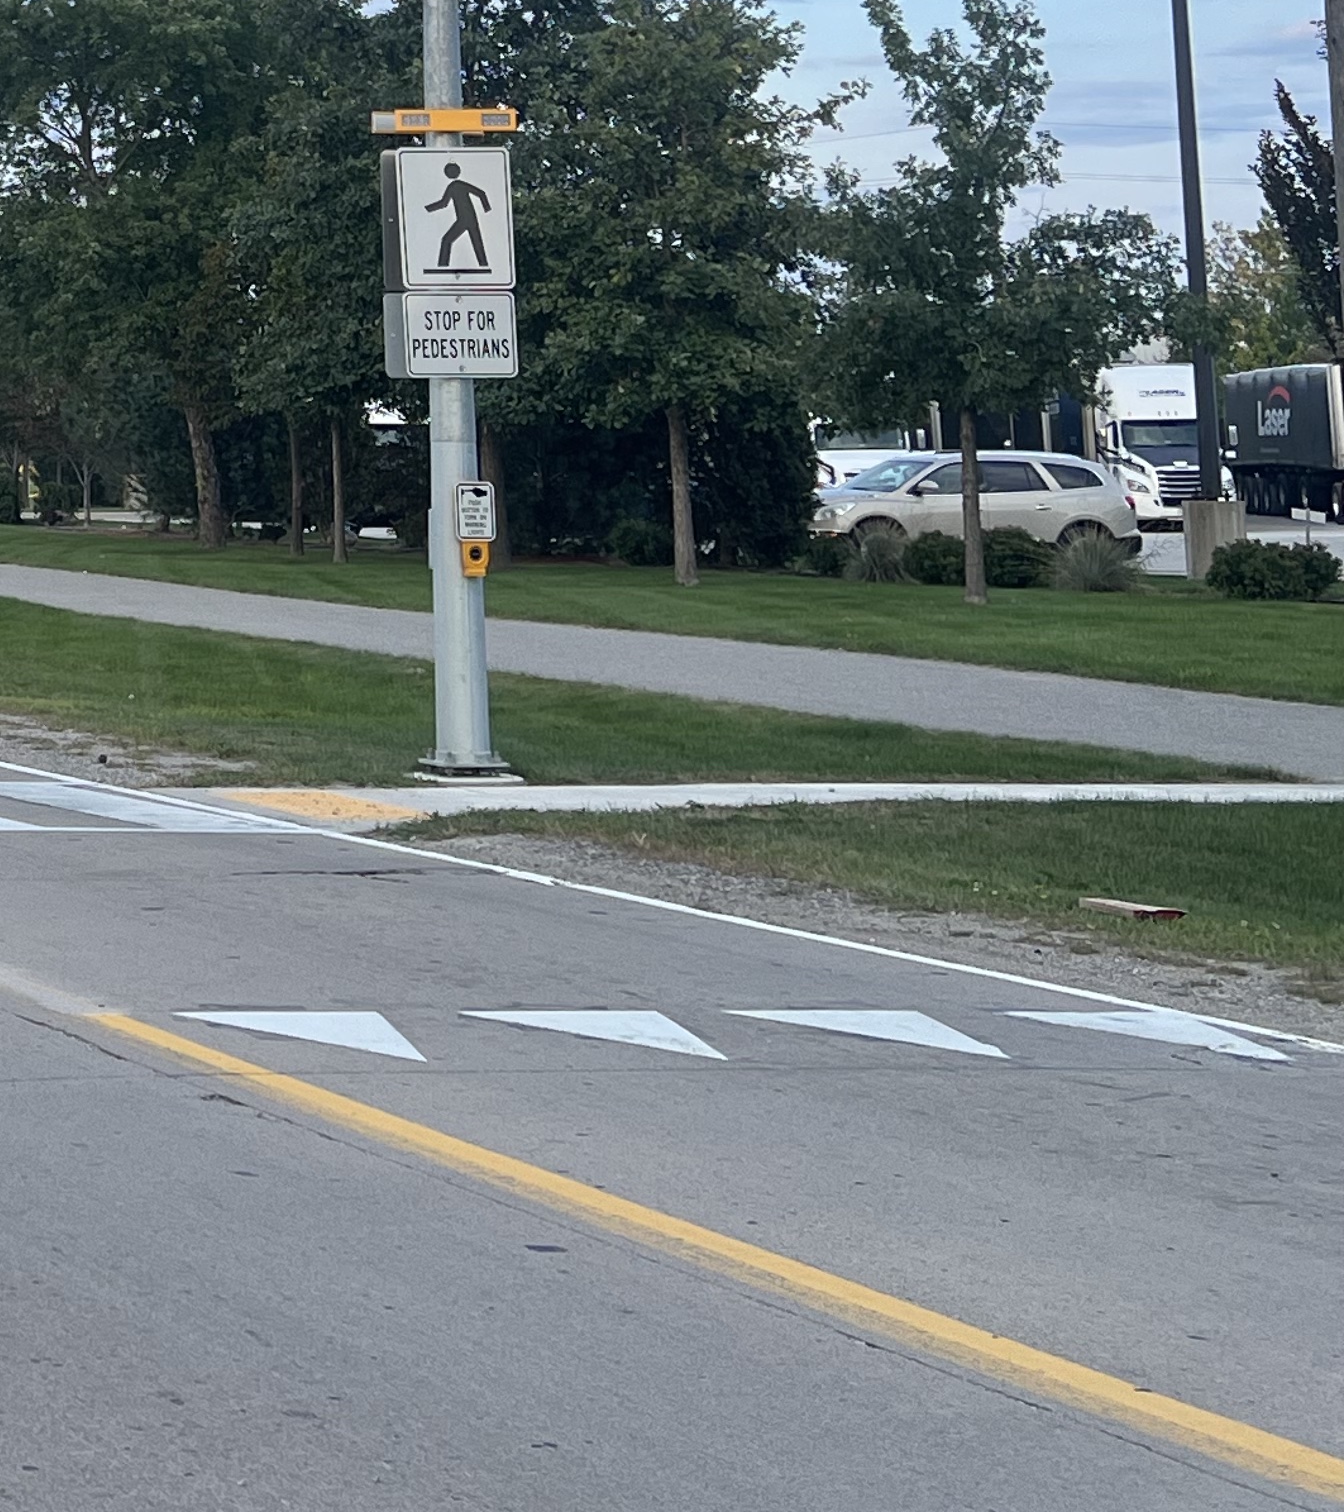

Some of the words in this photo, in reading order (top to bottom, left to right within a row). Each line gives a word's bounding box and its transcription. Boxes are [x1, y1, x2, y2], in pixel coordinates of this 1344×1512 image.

[424, 311, 461, 332] STOP
[467, 311, 496, 331] FOR
[412, 338, 510, 360] PEDESTRIANS
[1257, 400, 1291, 436] Laser
